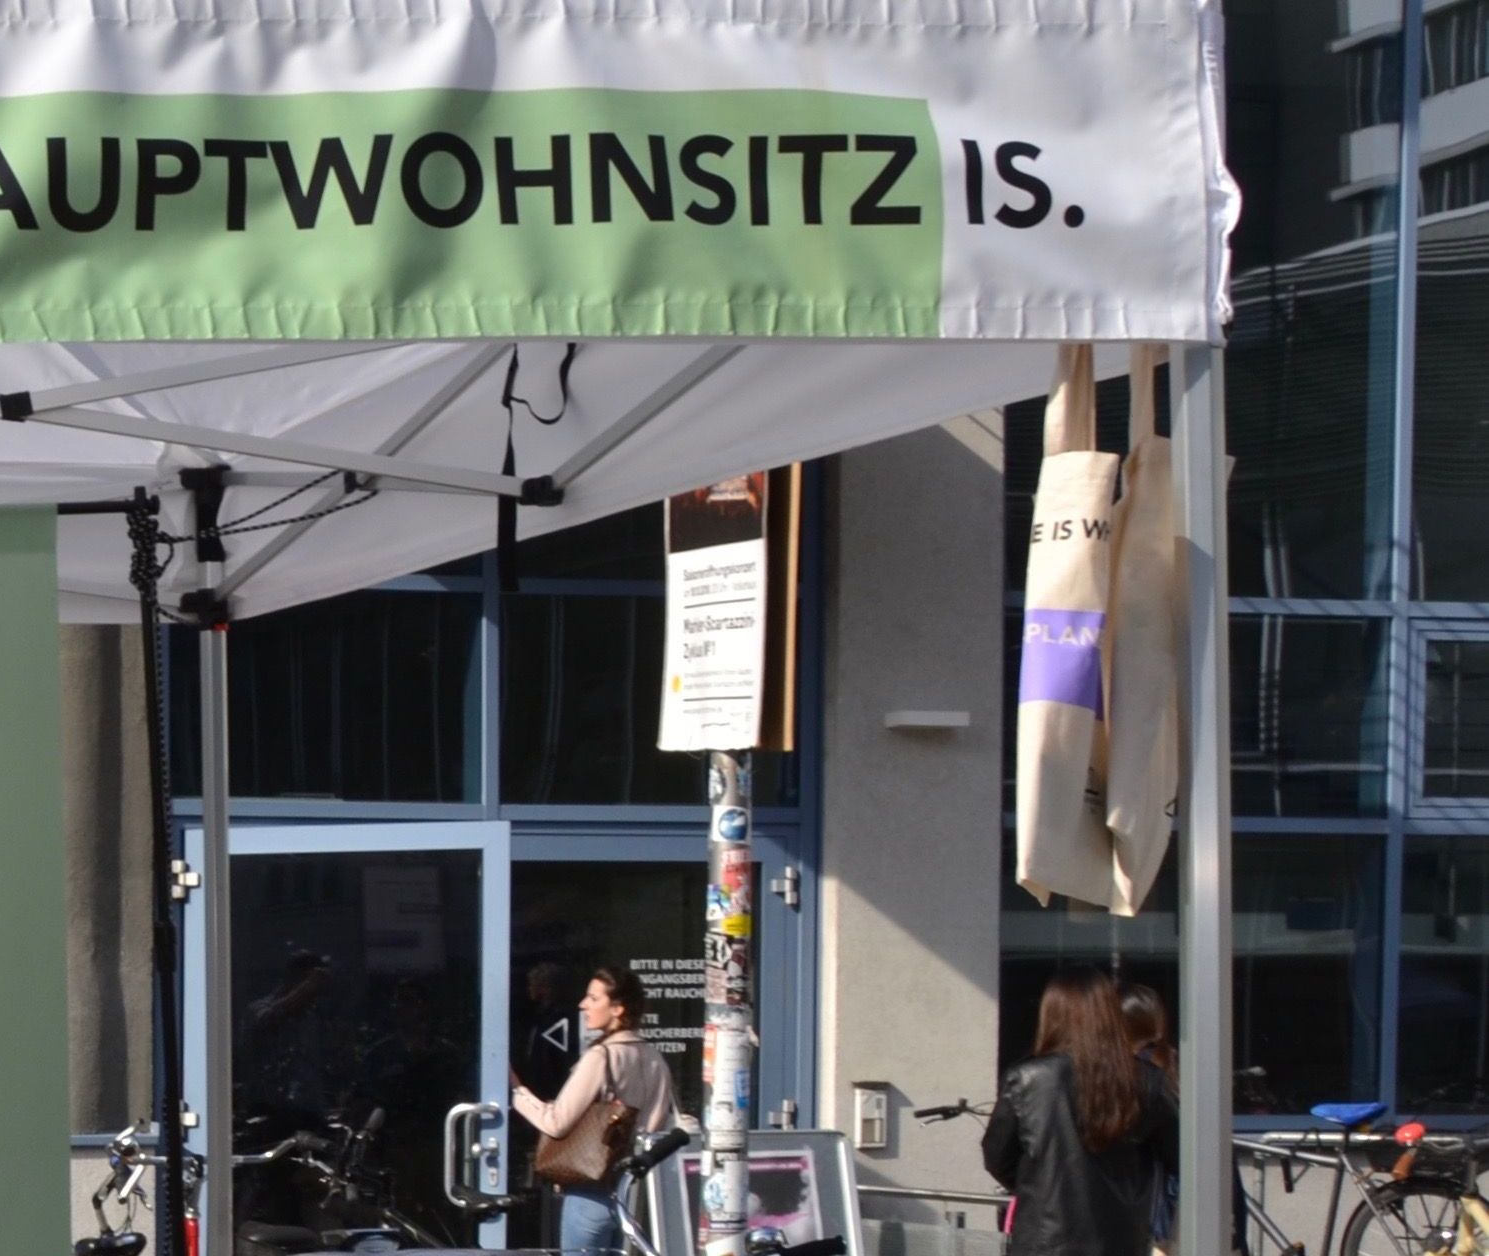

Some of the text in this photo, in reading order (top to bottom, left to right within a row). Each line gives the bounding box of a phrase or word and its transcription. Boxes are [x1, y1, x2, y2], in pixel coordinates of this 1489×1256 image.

[962, 139, 1085, 229] IS.
[629, 959, 705, 970] BITTE IN DIESE
[638, 973, 705, 985] NGANGSBER
[643, 987, 705, 998] CHT RAUCH
